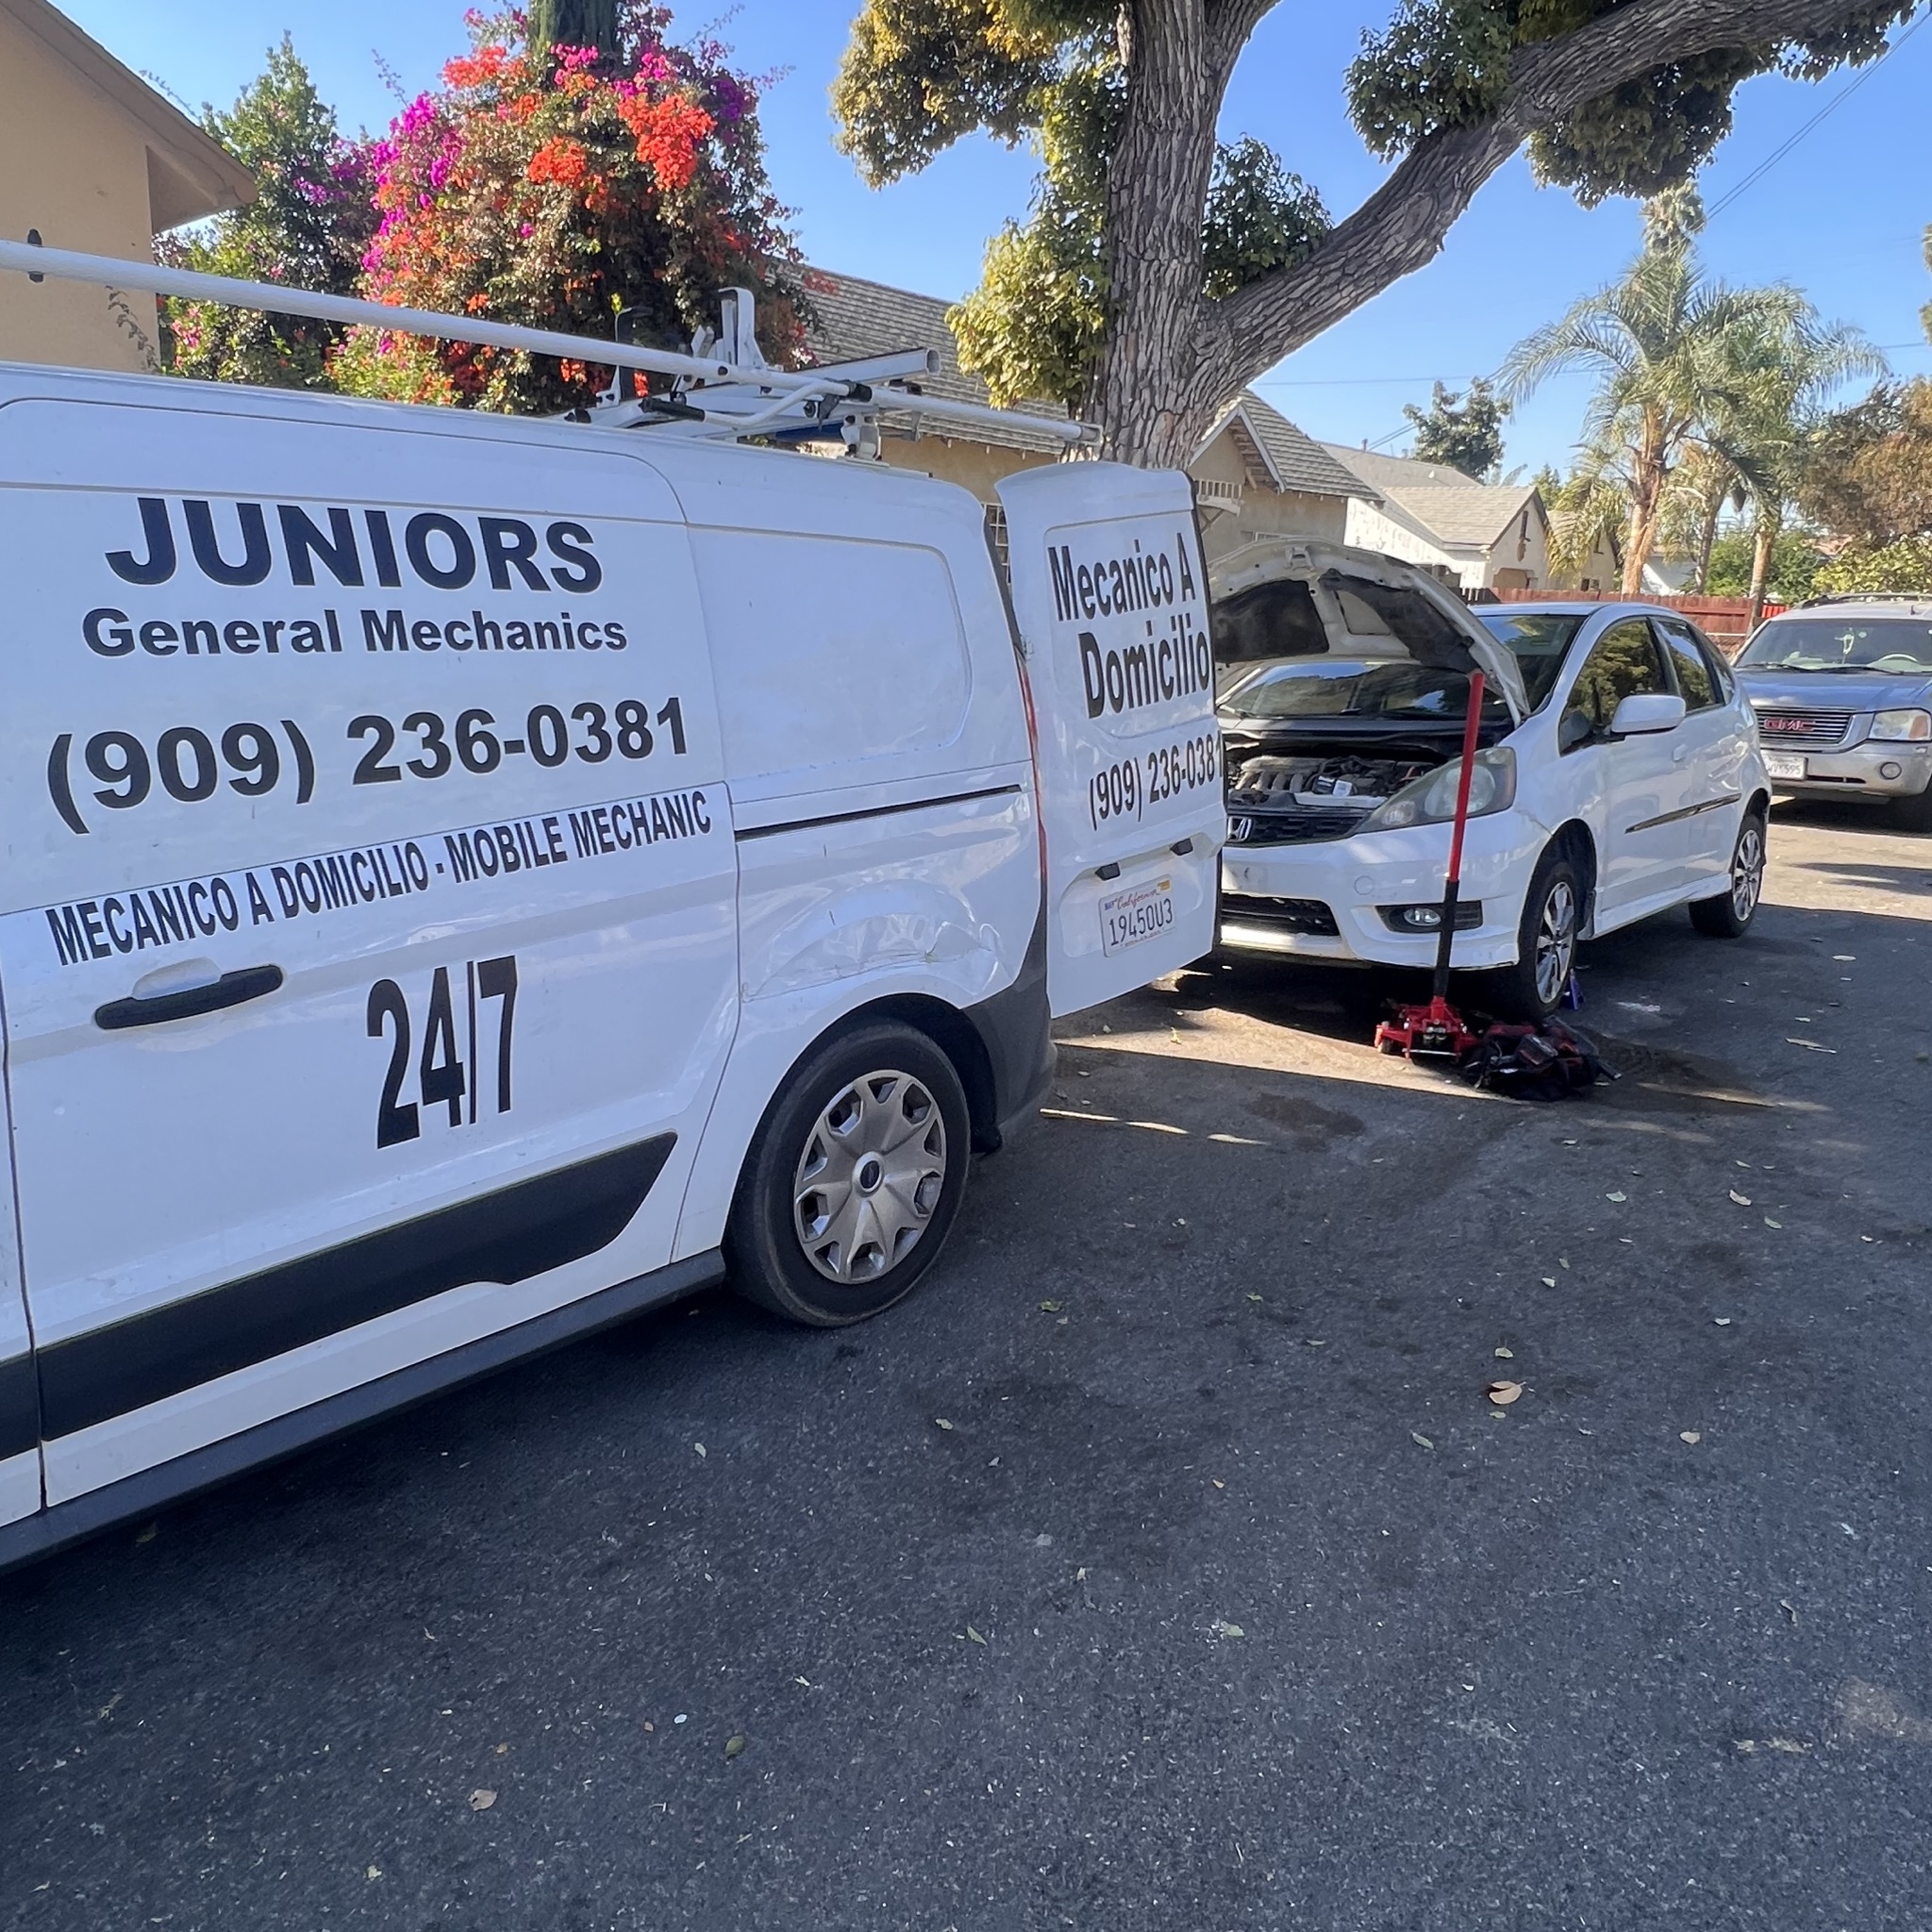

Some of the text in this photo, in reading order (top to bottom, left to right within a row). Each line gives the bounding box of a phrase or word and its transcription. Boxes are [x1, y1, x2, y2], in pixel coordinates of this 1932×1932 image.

[105, 497, 604, 594] JUNIORS
[1047, 532, 1196, 622] Mecanico A
[82, 608, 627, 658] General Mechanics
[1078, 612, 1209, 720] Domicilio
[47, 696, 688, 835] (909) 236-0381
[1764, 718, 1815, 731] GMC
[1090, 729, 1223, 831] (909) 236-0381
[45, 877, 239, 966] MECANICO
[245, 872, 275, 925] A
[270, 842, 428, 919] DOMICILIO
[443, 816, 568, 883] MOBILE
[568, 791, 711, 858] MECHANIC
[367, 955, 518, 1149] 24/7
